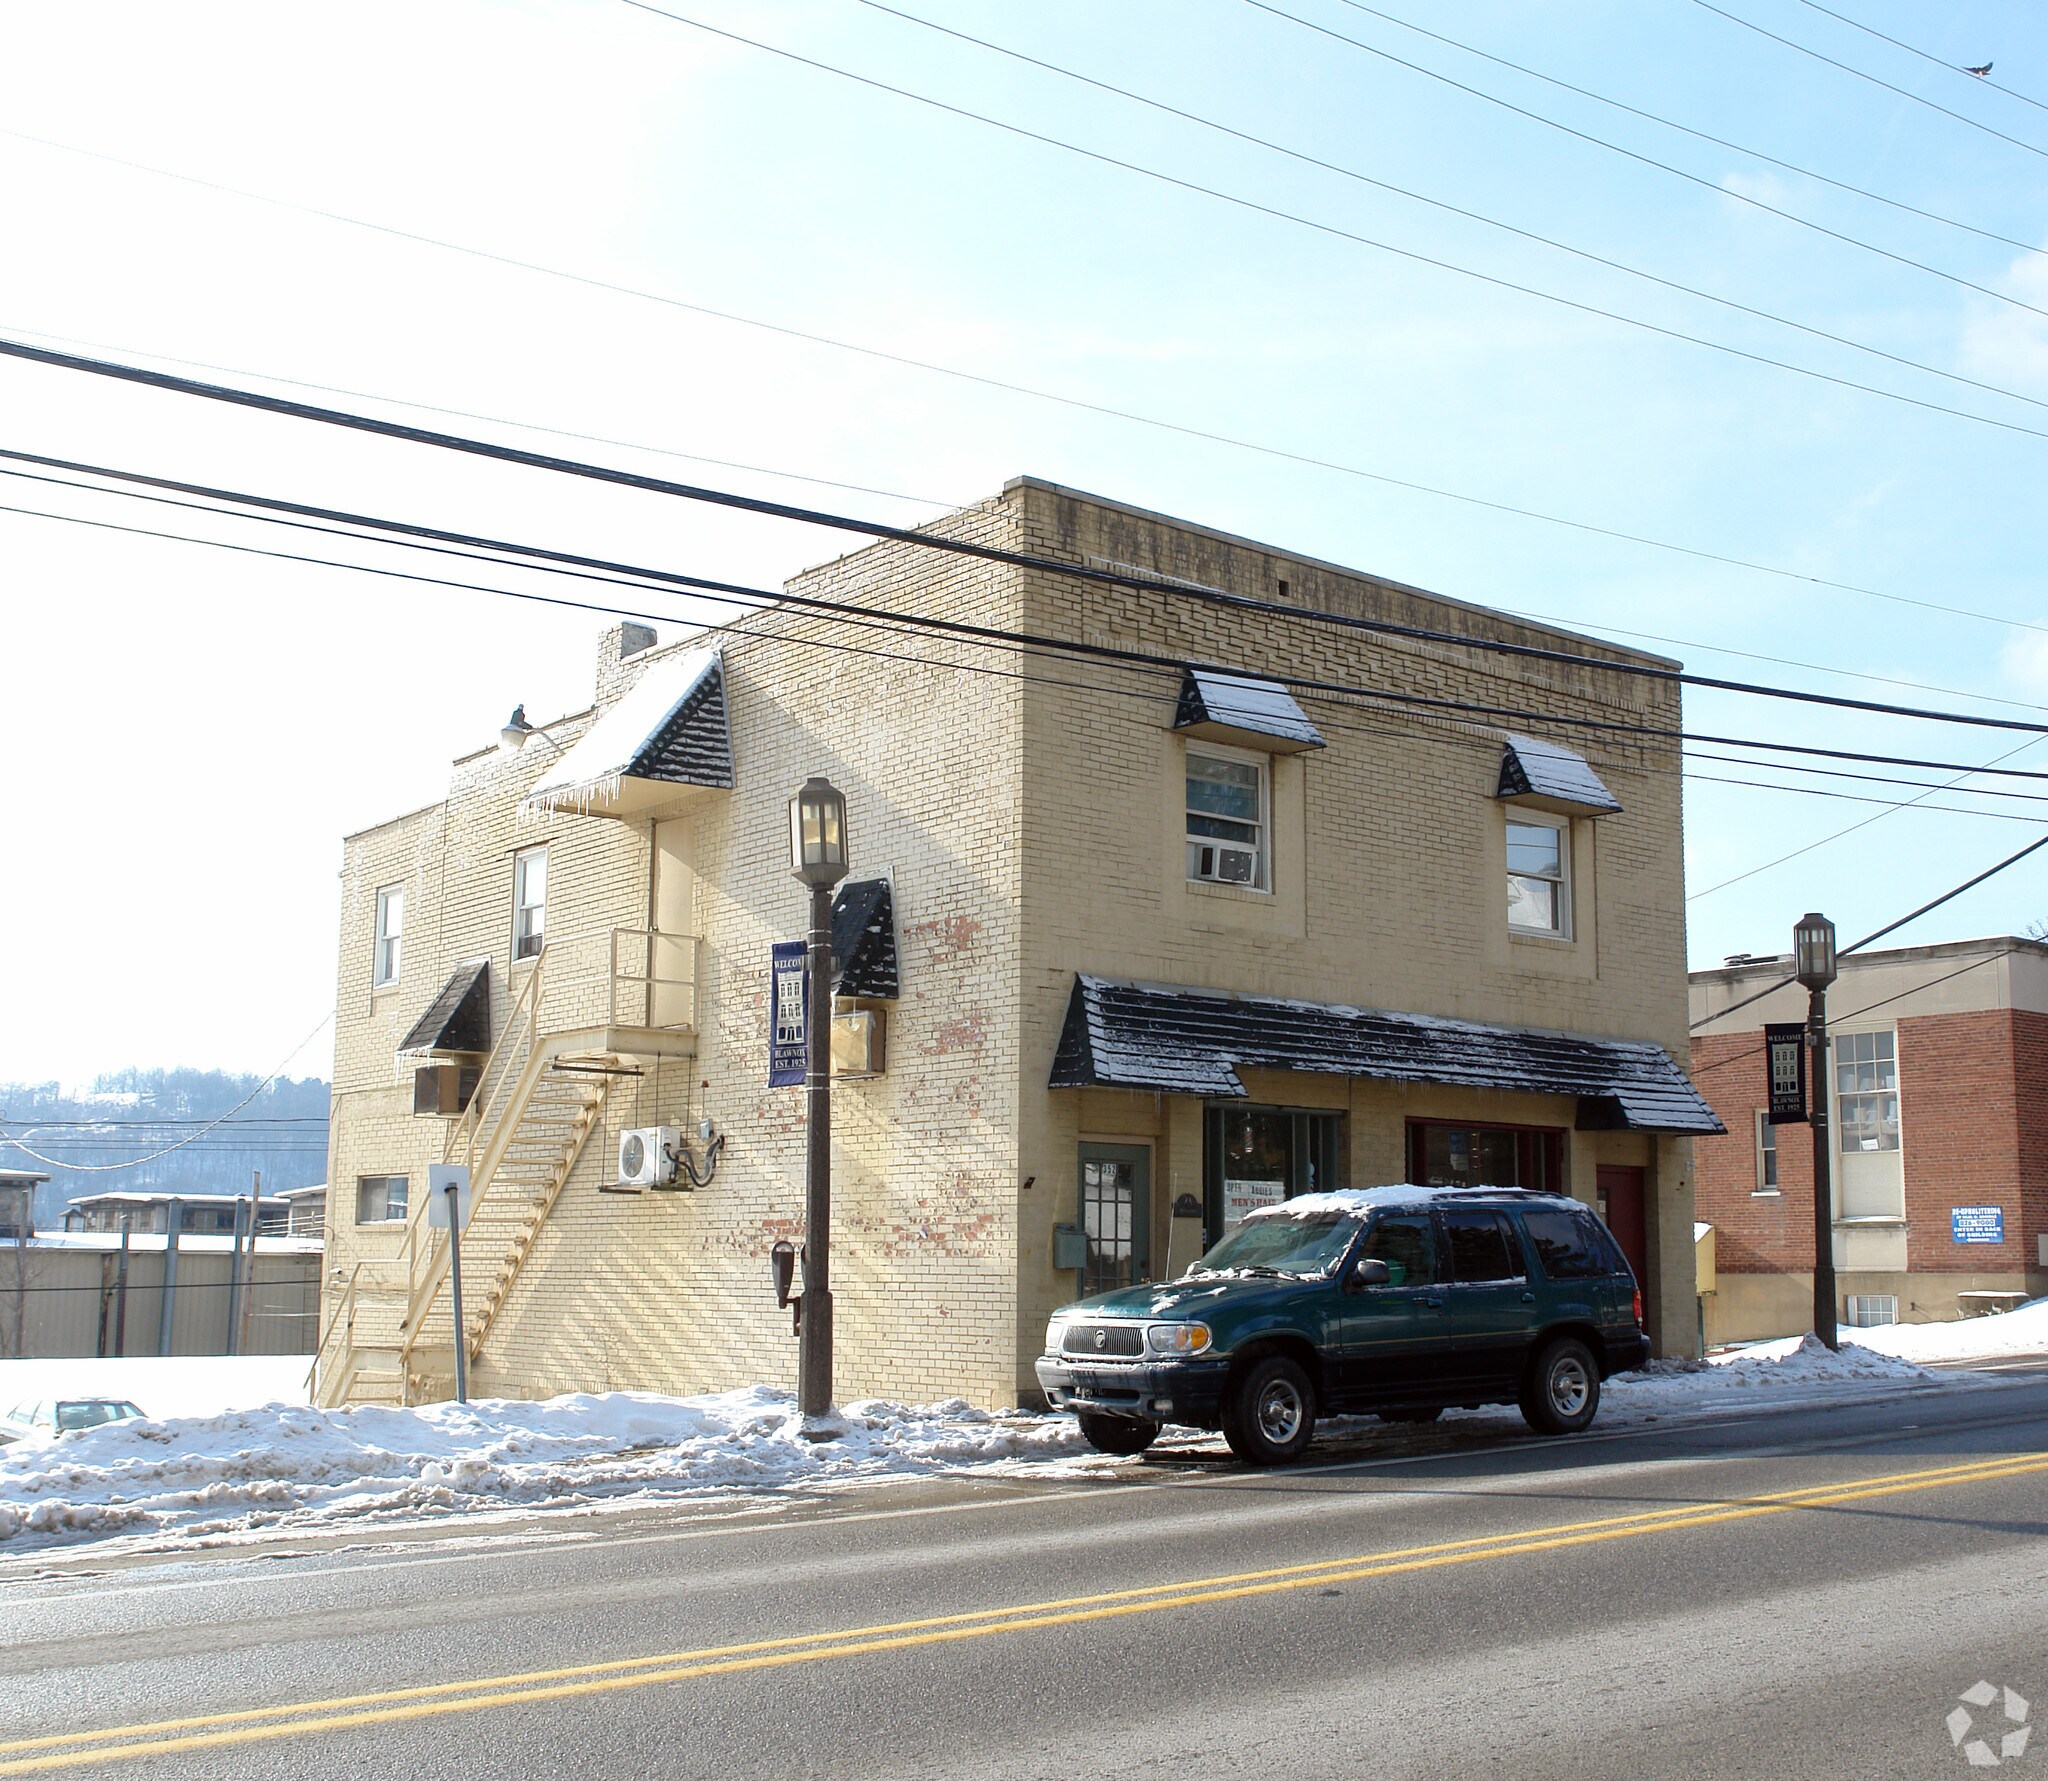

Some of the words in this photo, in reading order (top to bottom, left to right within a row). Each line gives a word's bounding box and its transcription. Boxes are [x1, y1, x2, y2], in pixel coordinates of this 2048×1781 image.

[775, 1048, 806, 1058] BLAWNOX
[776, 1060, 790, 1068] EST.
[791, 1058, 806, 1068] 1925
[1227, 1182, 1242, 1192] OPEN
[1232, 1198, 1255, 1207] MEN'S
